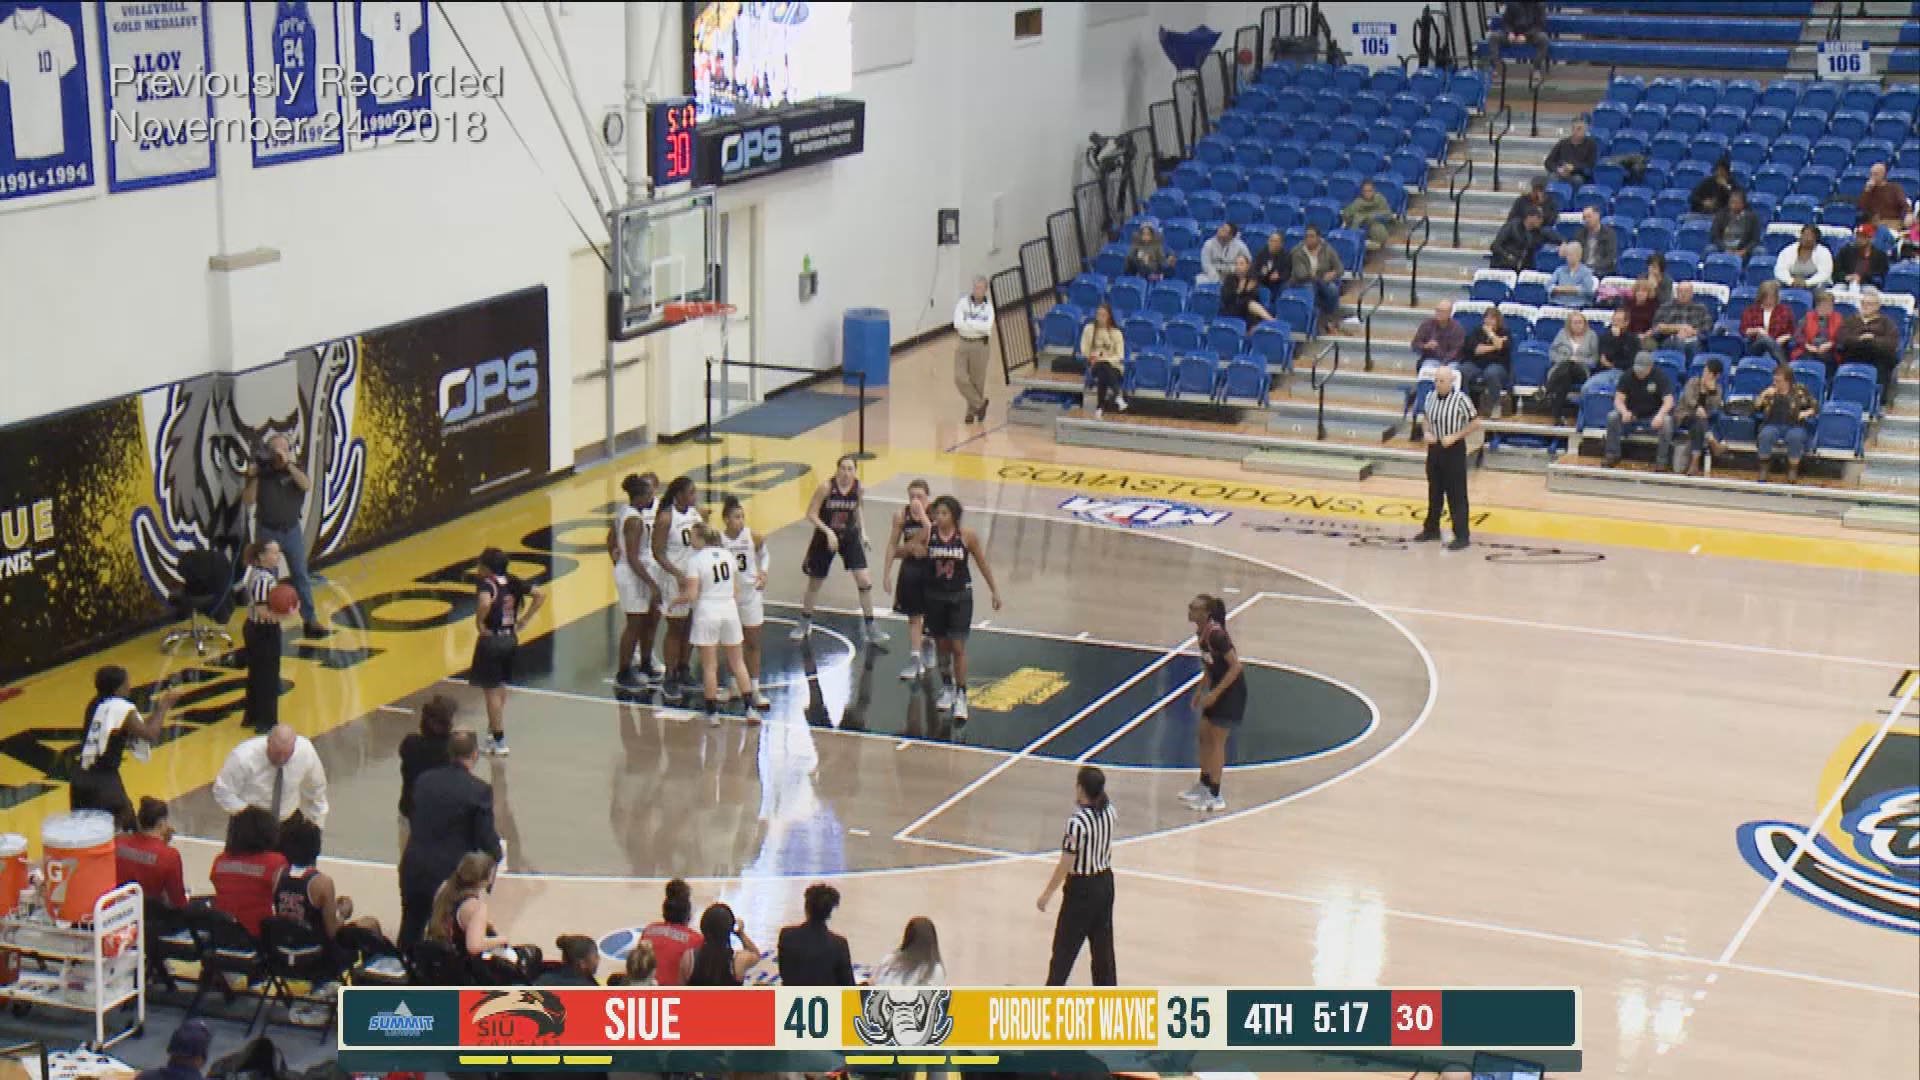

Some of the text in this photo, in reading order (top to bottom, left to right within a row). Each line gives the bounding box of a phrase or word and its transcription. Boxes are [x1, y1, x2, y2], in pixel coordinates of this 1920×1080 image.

[112, 15, 199, 33] GOLD MEDALIST
[283, 37, 305, 68] 24
[1361, 37, 1389, 56] 105
[38, 50, 52, 73] 10
[134, 50, 182, 73] LLOY
[1827, 53, 1861, 73] 106
[666, 132, 691, 177] 30
[720, 125, 782, 173] OPS
[0, 163, 88, 194] 1991-1994
[438, 348, 539, 424] OPS
[712, 560, 731, 584] 10
[736, 552, 748, 573] 3
